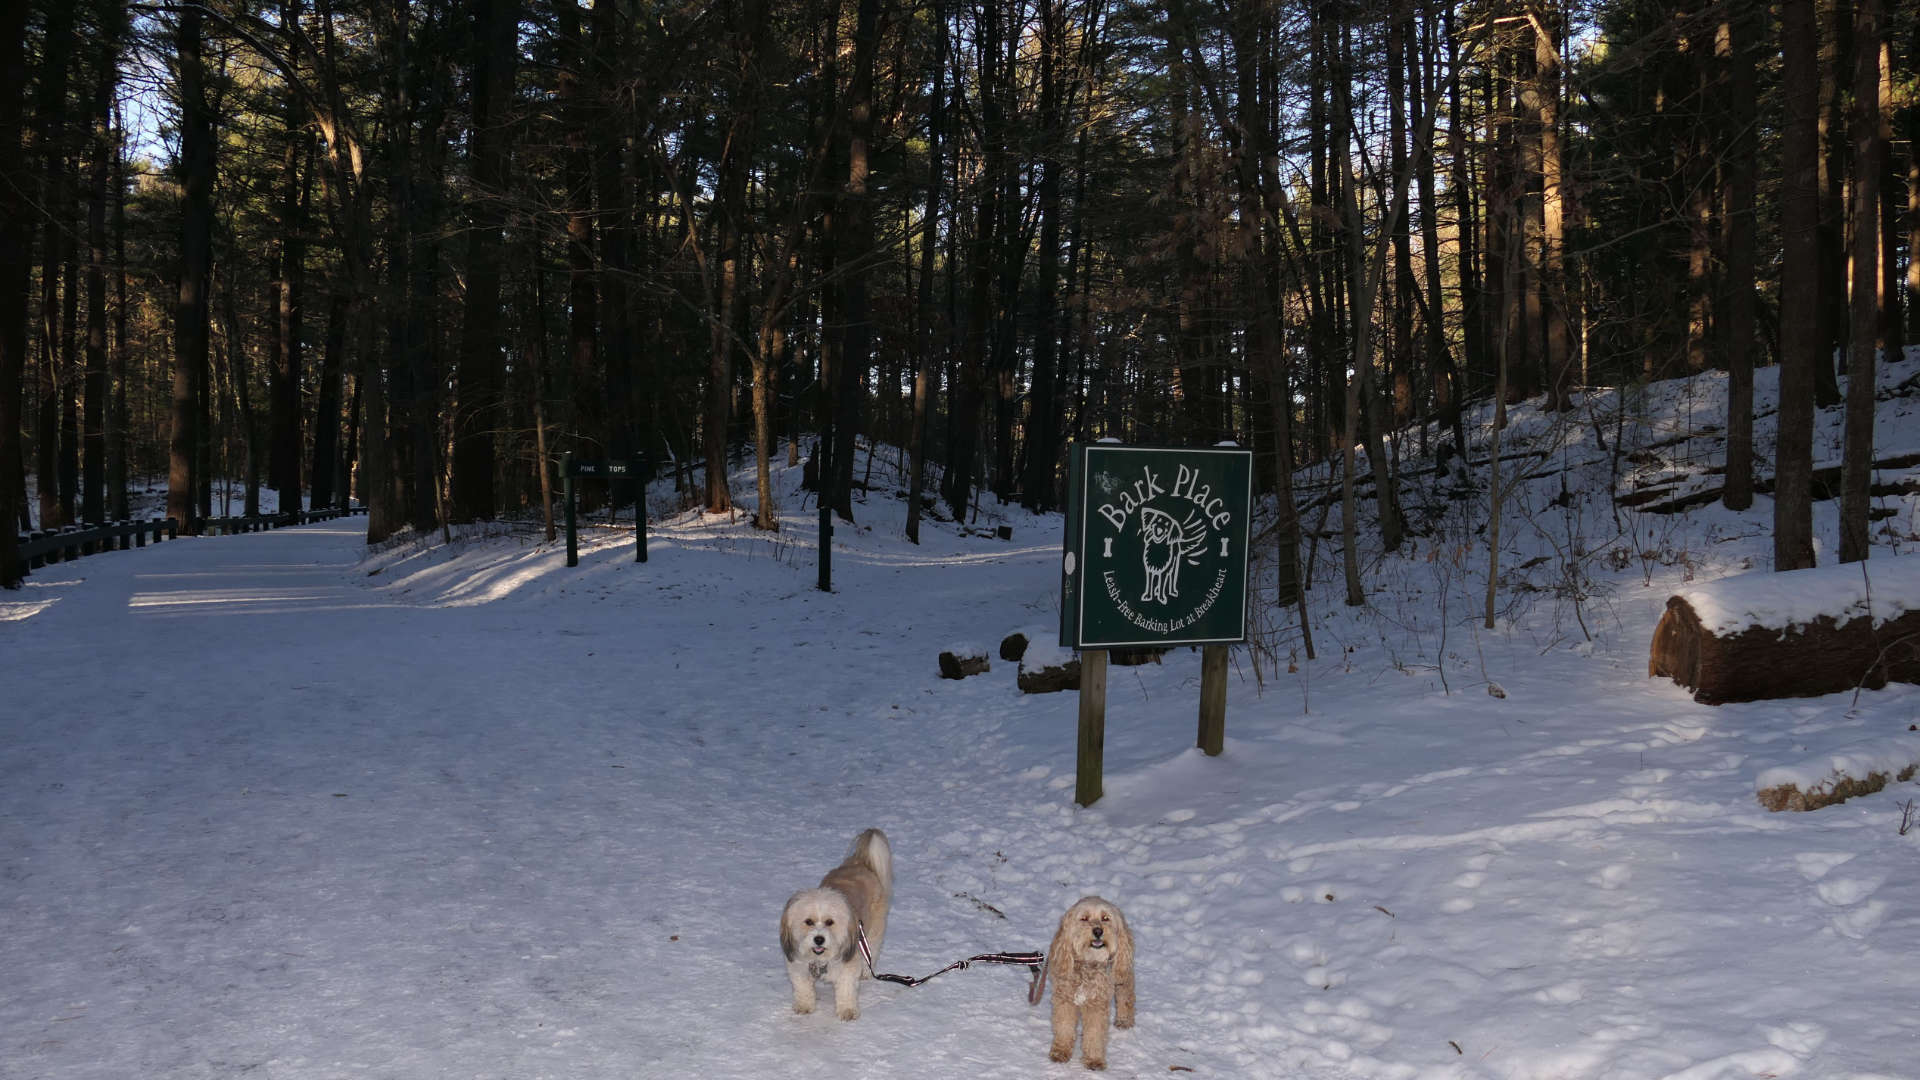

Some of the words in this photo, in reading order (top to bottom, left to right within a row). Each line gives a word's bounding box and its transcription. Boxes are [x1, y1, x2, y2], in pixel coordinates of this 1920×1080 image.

[1097, 465, 1165, 533] Bark
[1170, 464, 1231, 531] Place
[1103, 570, 1135, 620] Leash-Free
[1133, 613, 1169, 634] Barking
[1170, 618, 1185, 631] Lot
[1186, 612, 1196, 625] at
[1194, 567, 1227, 619] Breakheart
